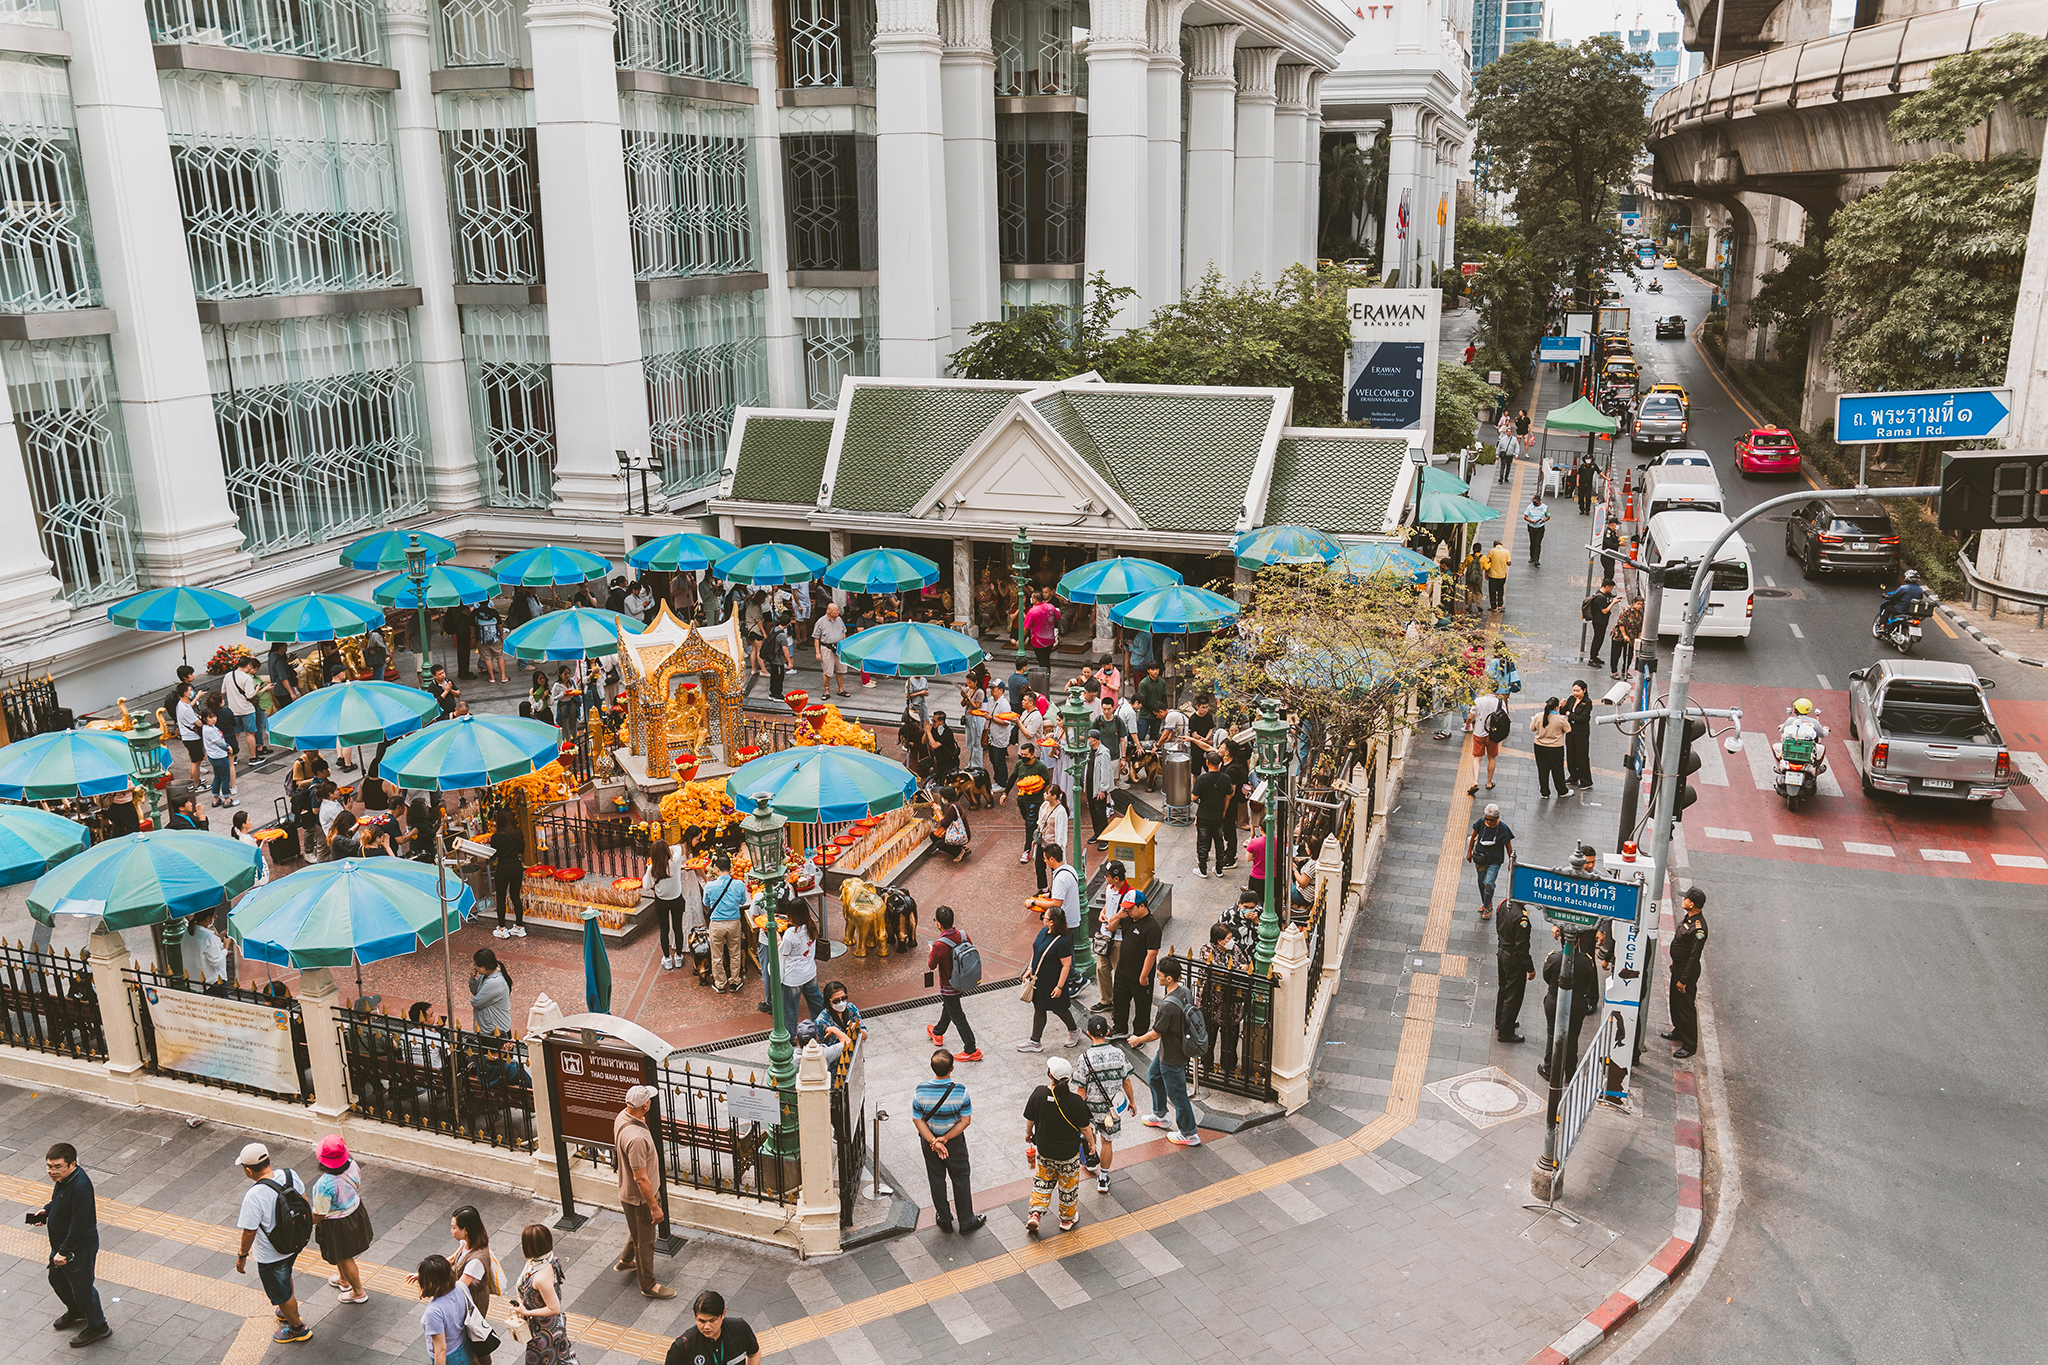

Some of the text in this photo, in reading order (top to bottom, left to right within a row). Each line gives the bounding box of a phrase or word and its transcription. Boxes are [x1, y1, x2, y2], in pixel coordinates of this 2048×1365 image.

[1353, 303, 1426, 322] ERAWAN
[1371, 366, 1401, 374] ERAWAN
[1355, 388, 1415, 398] WELCOME TO
[1876, 427, 1912, 438] Rama
[1925, 425, 1946, 436] Rd.
[1533, 876, 1617, 902] ถนนราชดำริ
[1533, 890, 1616, 912] Thanon Ratchadamri
[588, 1050, 640, 1072] ท้าวมหาพรหม
[590, 1070, 641, 1085] THAO MAHA BRAHMA
